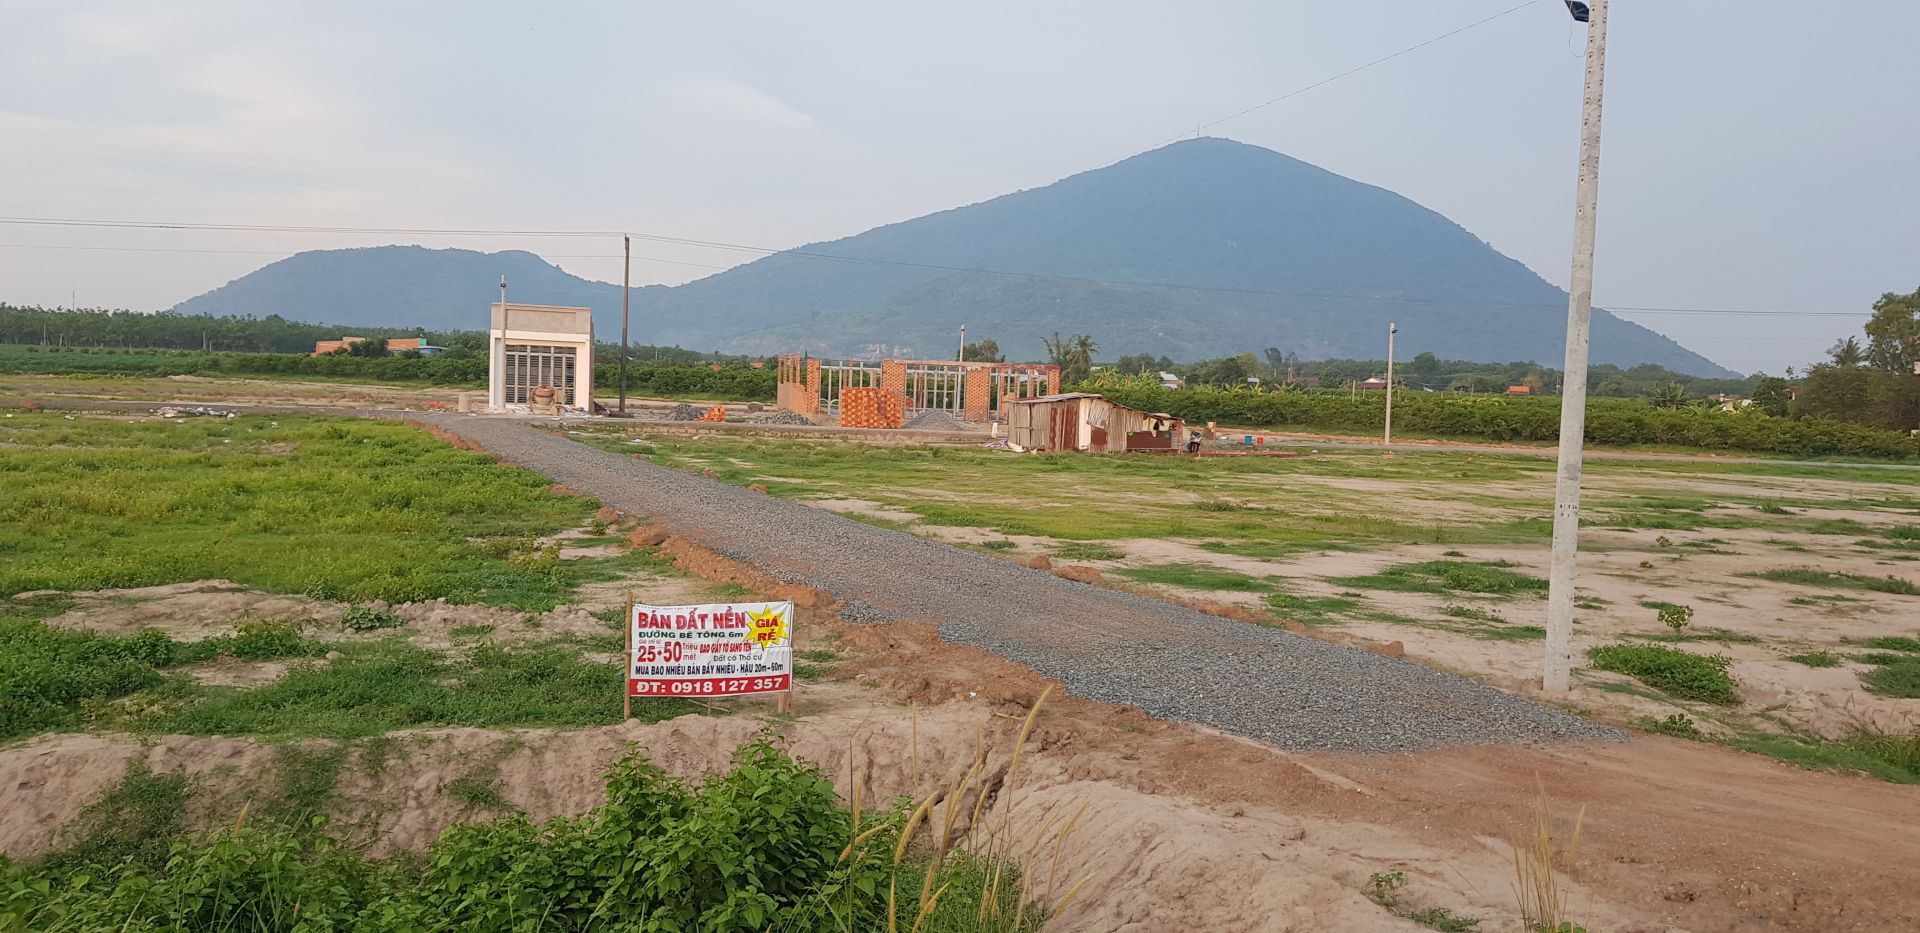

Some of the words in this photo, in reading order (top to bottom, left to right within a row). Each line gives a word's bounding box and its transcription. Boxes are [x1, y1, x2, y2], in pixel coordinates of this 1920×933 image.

[637, 609, 672, 630] BÁN
[676, 607, 709, 630] ĐẤT
[713, 605, 746, 630] NỀN
[755, 615, 779, 628] GIÁ
[638, 631, 676, 639] ĐƯỜNG
[679, 631, 693, 639] BÊ
[696, 631, 726, 639] TÔNG
[757, 628, 777, 641] RẺ
[682, 642, 698, 651] Triệu
[700, 643, 710, 653] BAO
[729, 642, 742, 652] SANG
[683, 652, 697, 661] mét
[713, 653, 726, 662] Đất
[727, 653, 737, 661] có
[635, 665, 650, 676] MUA
[651, 665, 664, 675] BAO
[665, 663, 686, 676] NHIÊU
[687, 662, 701, 676] BÁN
[701, 661, 715, 675] BẤY
[715, 662, 736, 675] NHIÊU
[740, 661, 754, 676] HẬU
[636, 681, 666, 693] ĐT:
[671, 681, 713, 694] 0918
[719, 680, 749, 692] 127
[753, 677, 783, 690] 357
